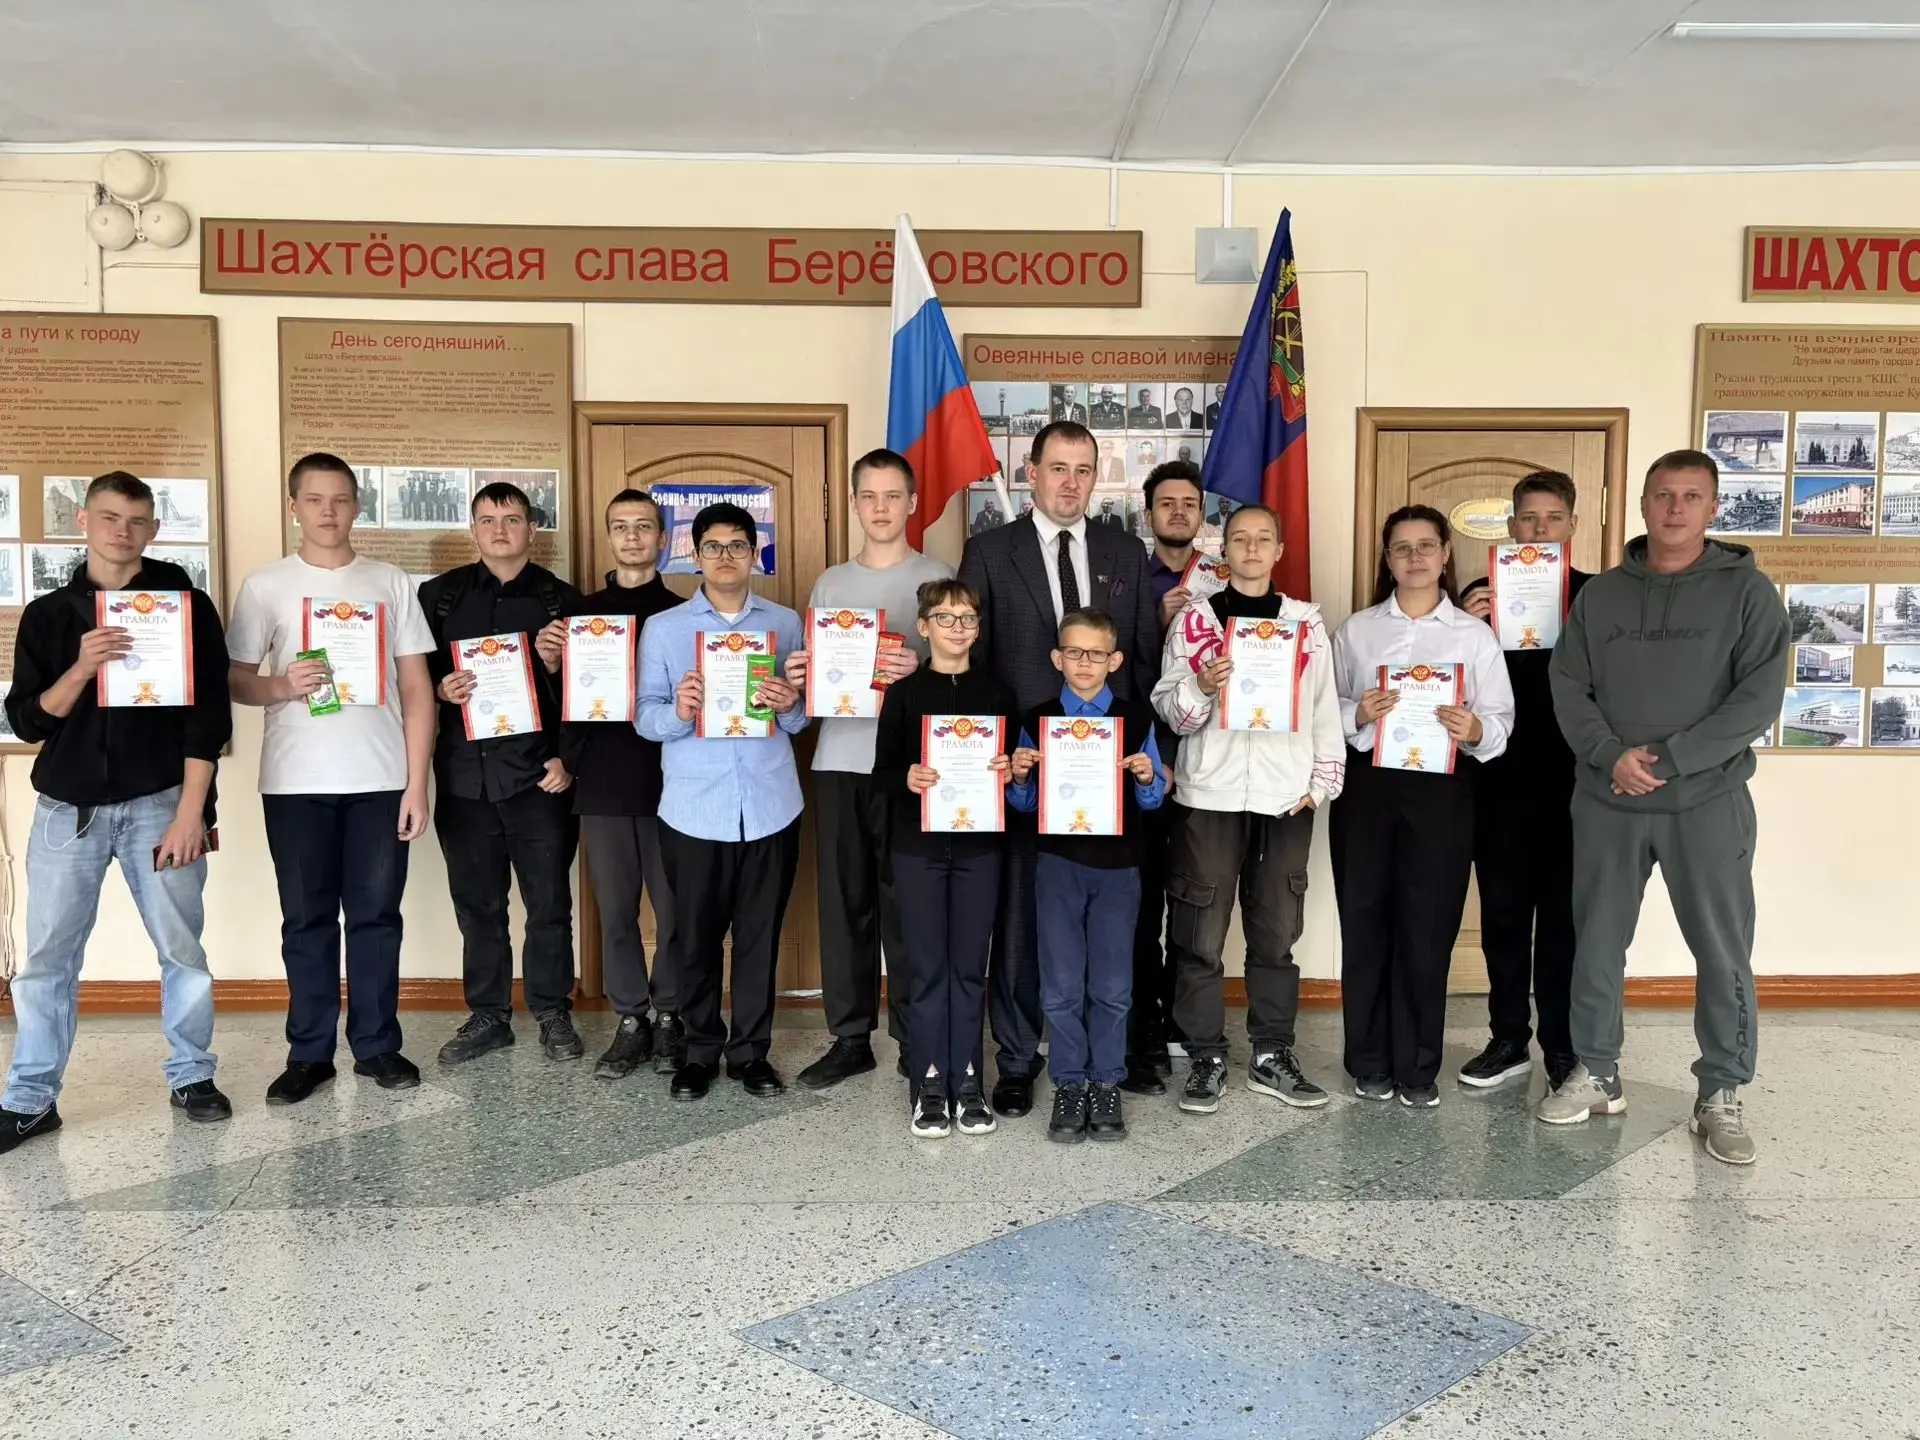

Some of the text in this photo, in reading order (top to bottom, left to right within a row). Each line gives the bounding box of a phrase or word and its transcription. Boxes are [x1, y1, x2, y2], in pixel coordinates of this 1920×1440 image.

[217, 228, 1128, 294] Шахтёрская слава Берёовского
[20, 327, 59, 343] пути
[66, 328, 74, 340] к
[81, 328, 140, 343] городу
[331, 331, 377, 349] День
[1710, 332, 1781, 343] Память
[1788, 335, 1808, 343] на
[1816, 335, 1883, 344] вечные
[974, 345, 1083, 365] Овеянные
[1092, 346, 1167, 366] славой
[1508, 566, 1548, 575] ГРАМОТА
[1200, 574, 1226, 589] ГРАМО
[120, 615, 168, 624] ГРАМОТА
[323, 621, 364, 630] ГРАМОТА
[825, 630, 865, 639] ГРАМОТА
[579, 637, 616, 646] ГРАМОТА
[1243, 641, 1282, 651] ГРАМОТА
[473, 655, 512, 667] ГРАМОТА
[716, 653, 747, 662] ГРАМО
[1400, 682, 1441, 692] ГРАМОТА
[941, 740, 984, 749] ГРАМОТА
[1059, 742, 1101, 751] ГРАМОТА
